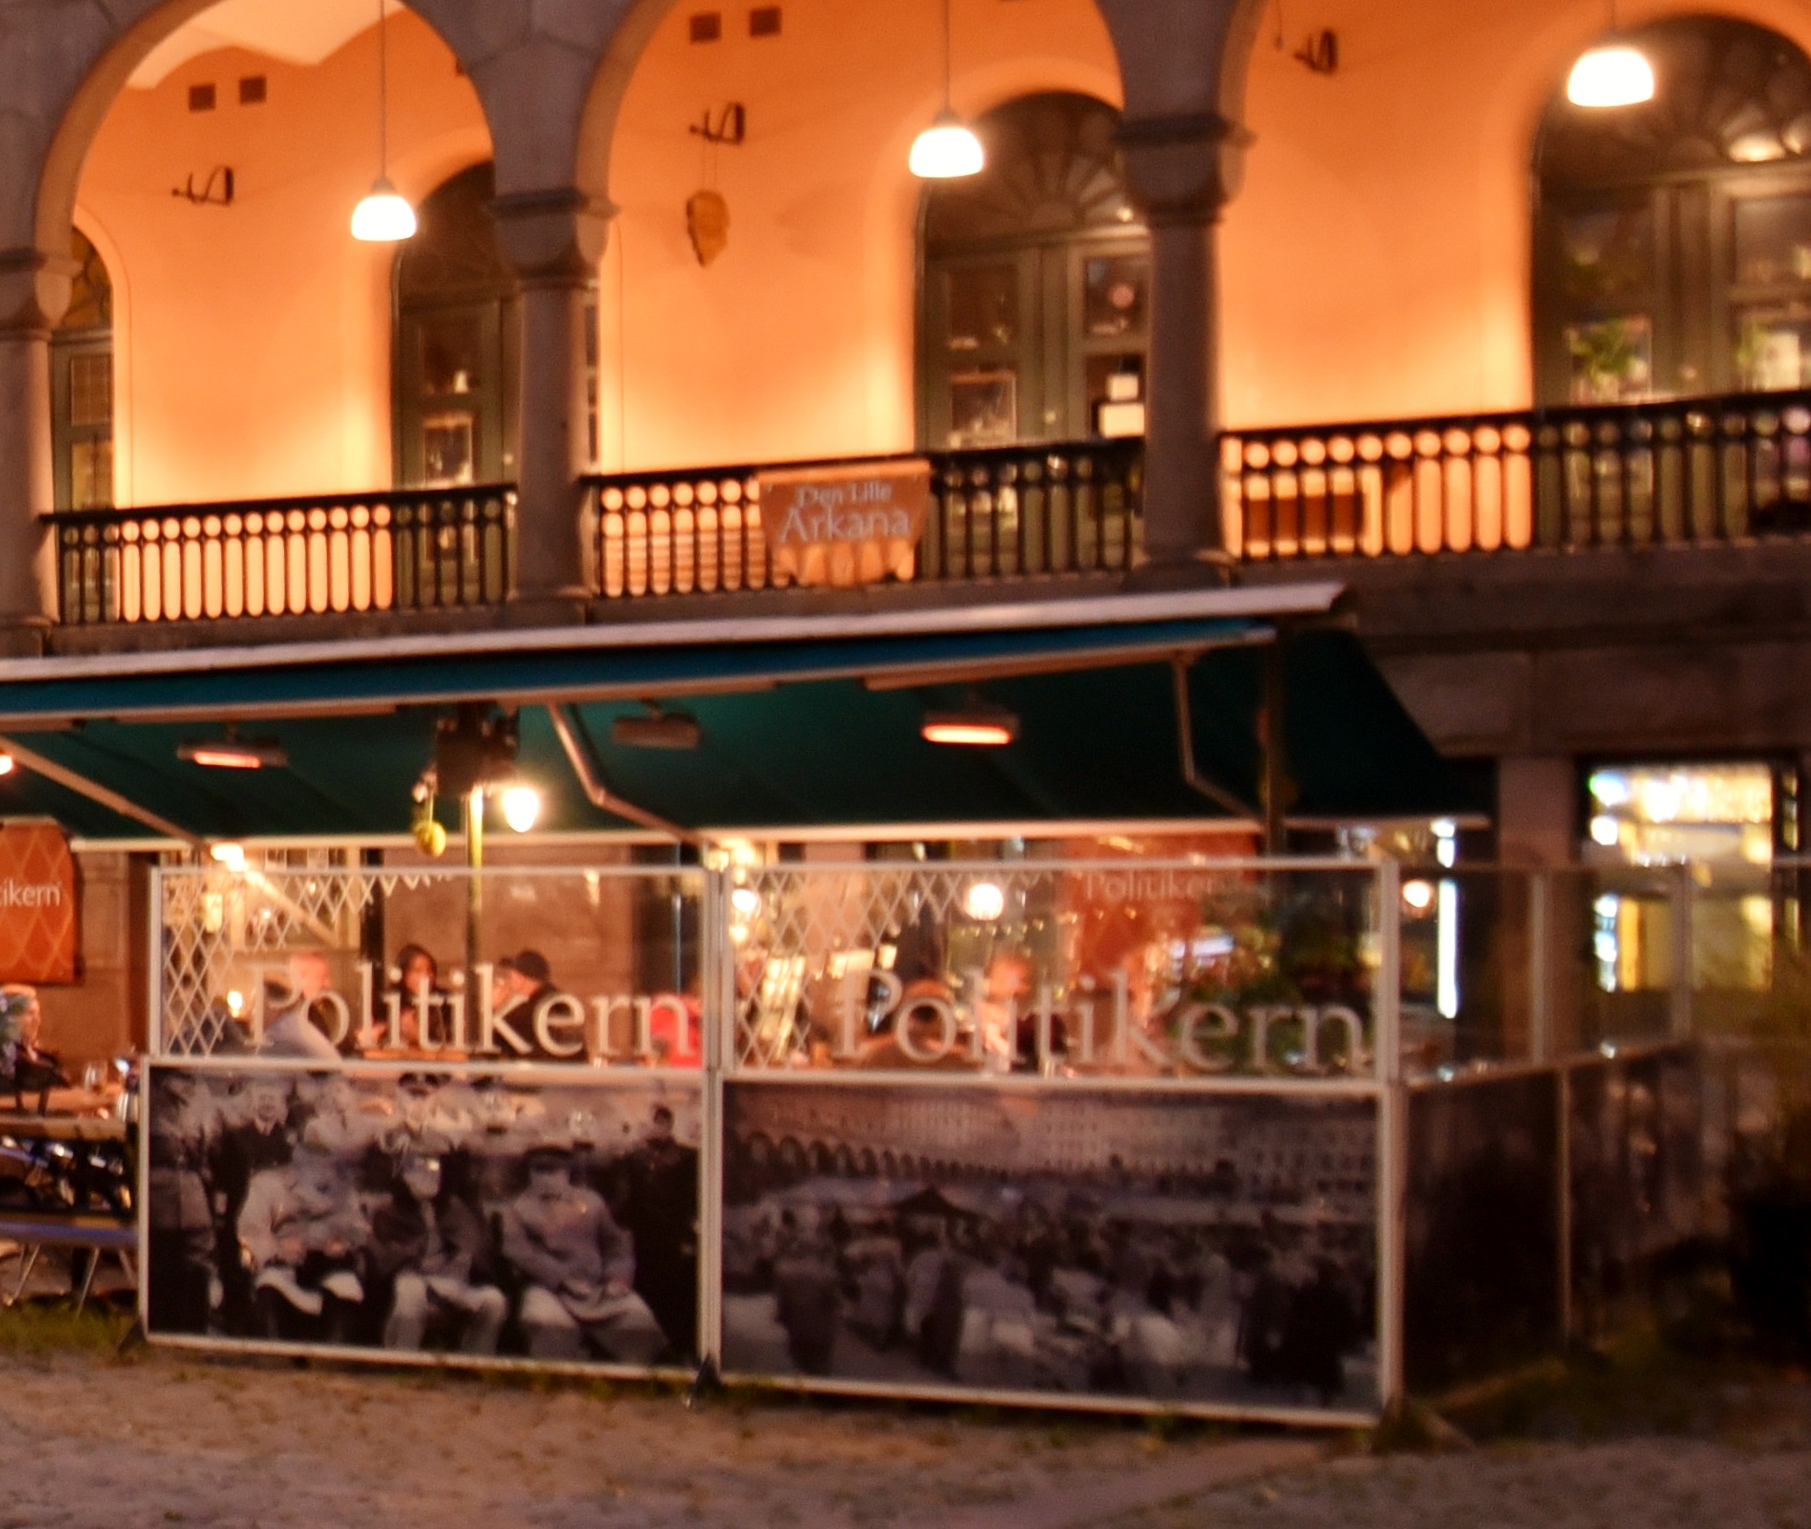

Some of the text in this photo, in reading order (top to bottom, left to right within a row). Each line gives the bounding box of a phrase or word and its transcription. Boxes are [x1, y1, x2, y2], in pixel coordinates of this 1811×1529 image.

[780, 504, 911, 544] Arkana
[796, 479, 893, 507] Den Lille
[244, 961, 695, 1057] Politikern
[831, 968, 1375, 1072] Politikern
